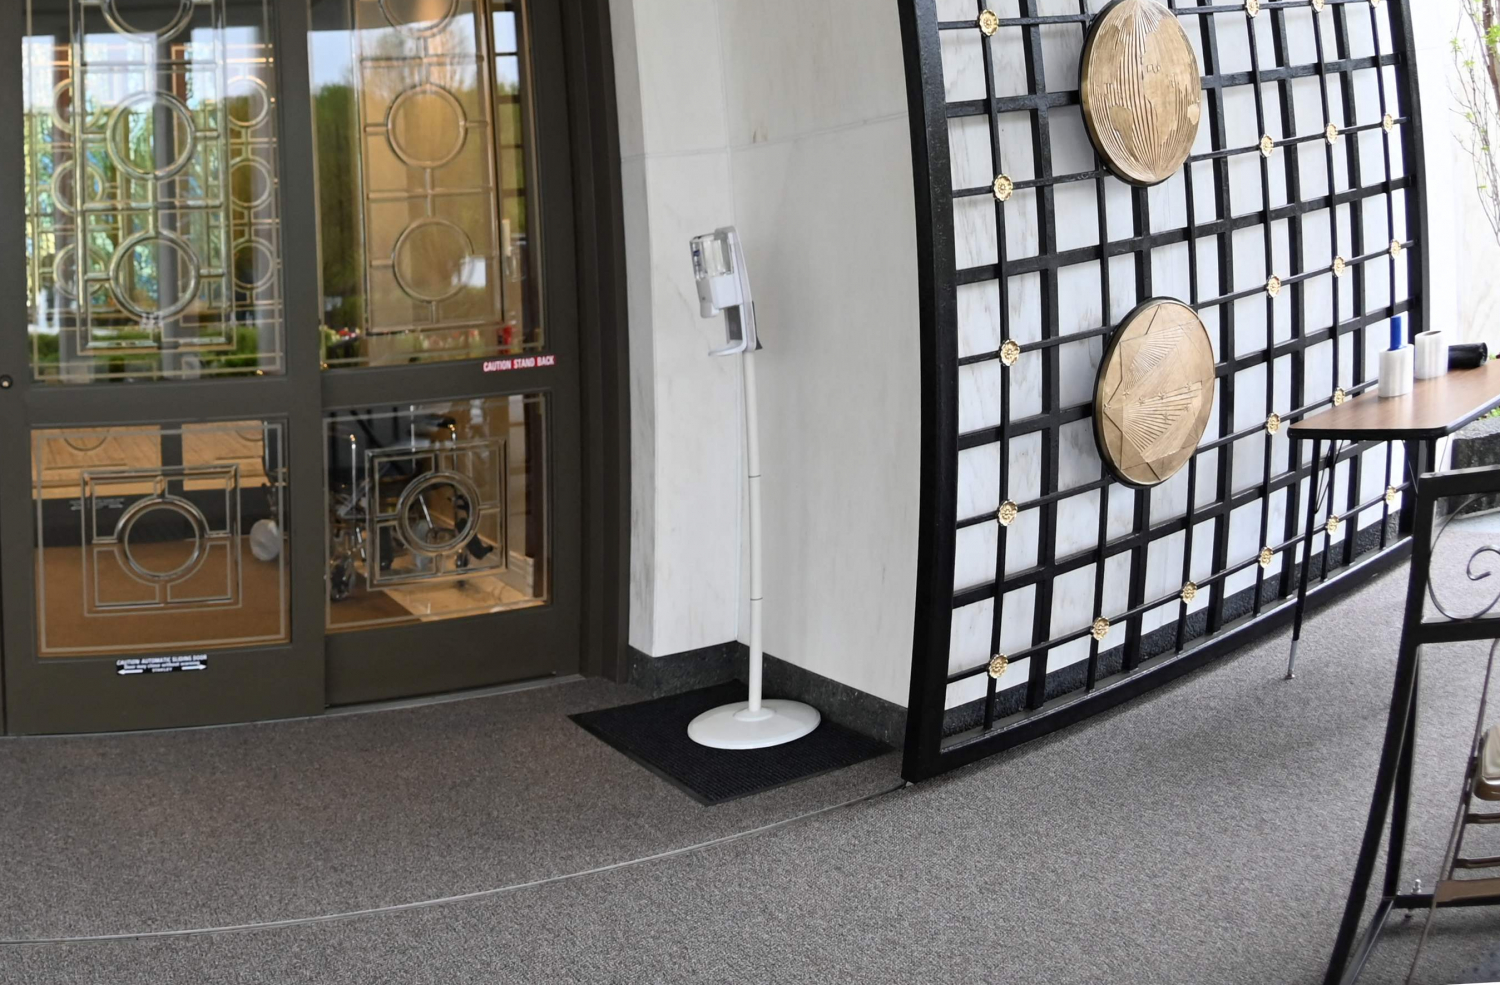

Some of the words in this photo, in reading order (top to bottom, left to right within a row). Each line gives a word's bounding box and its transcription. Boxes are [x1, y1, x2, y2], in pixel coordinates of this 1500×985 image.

[483, 360, 512, 372] CAUTION
[513, 357, 535, 369] STAND
[537, 355, 555, 366] BACK
